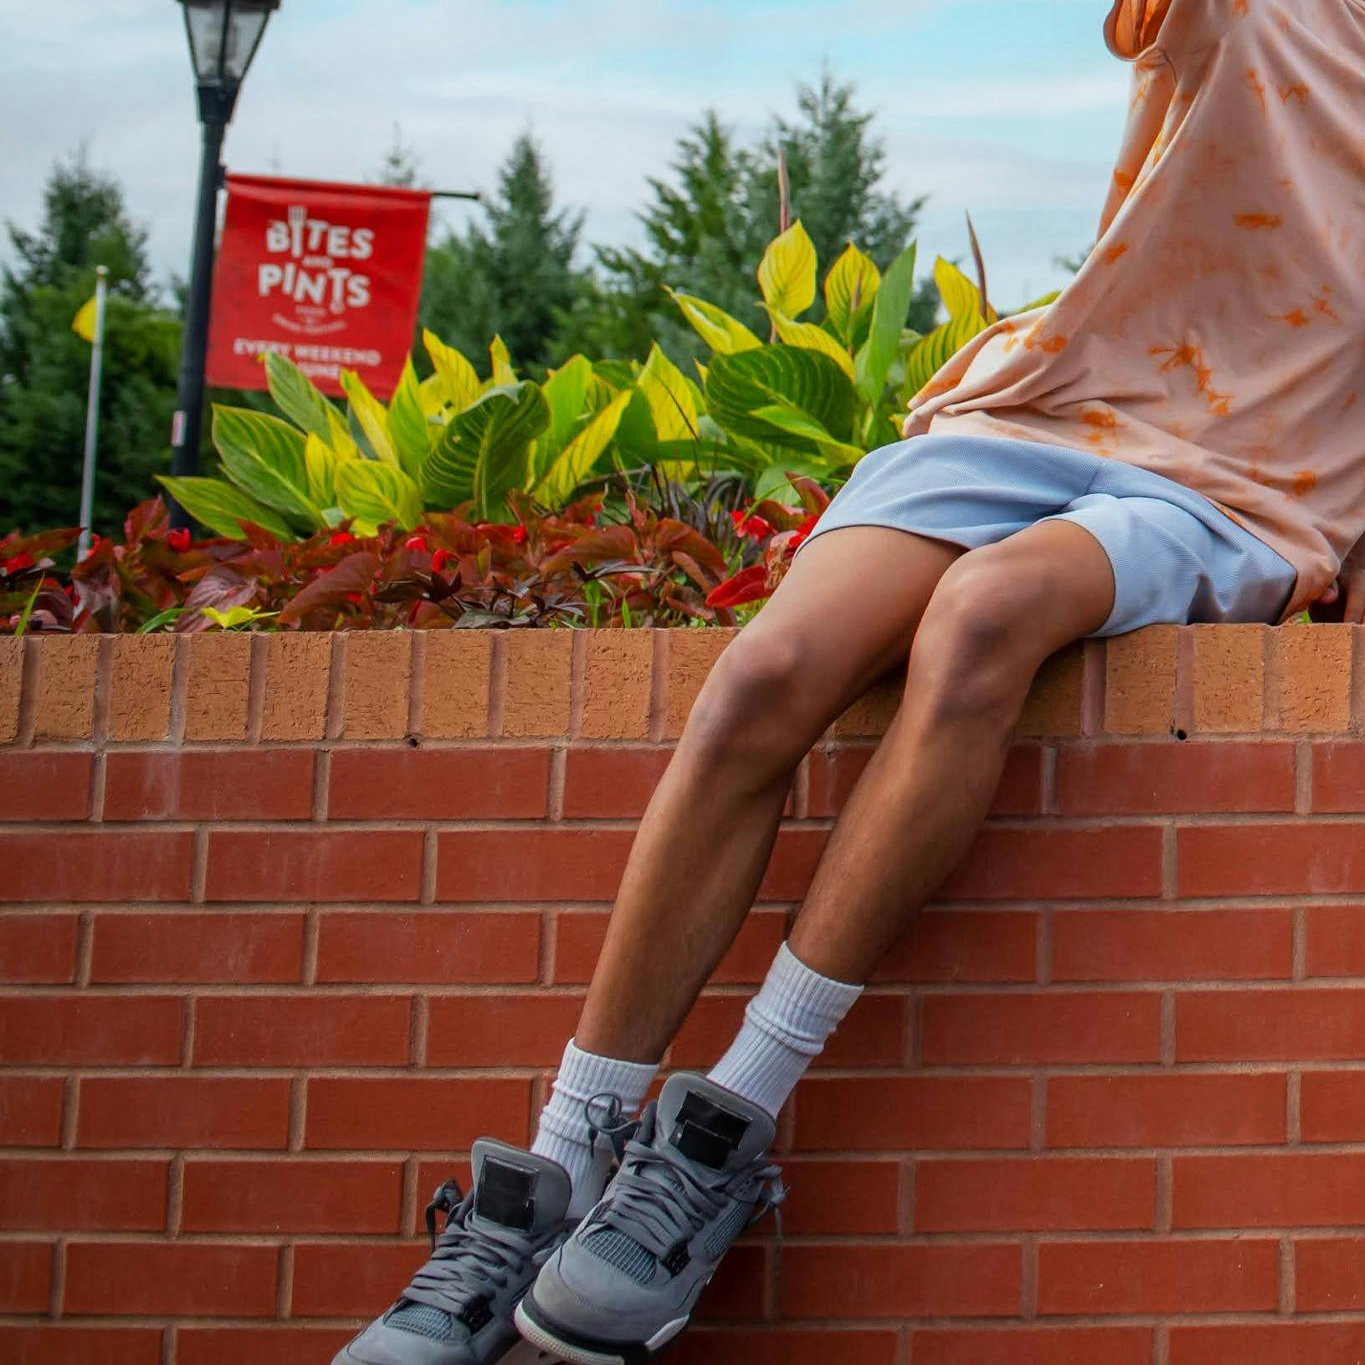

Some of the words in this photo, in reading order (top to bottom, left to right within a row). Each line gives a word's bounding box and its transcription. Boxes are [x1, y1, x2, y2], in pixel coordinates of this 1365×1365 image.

[266, 205, 376, 261] BITES
[258, 262, 371, 315] PINTS
[233, 337, 290, 357] EVERY
[294, 343, 382, 367] WEEKEND
